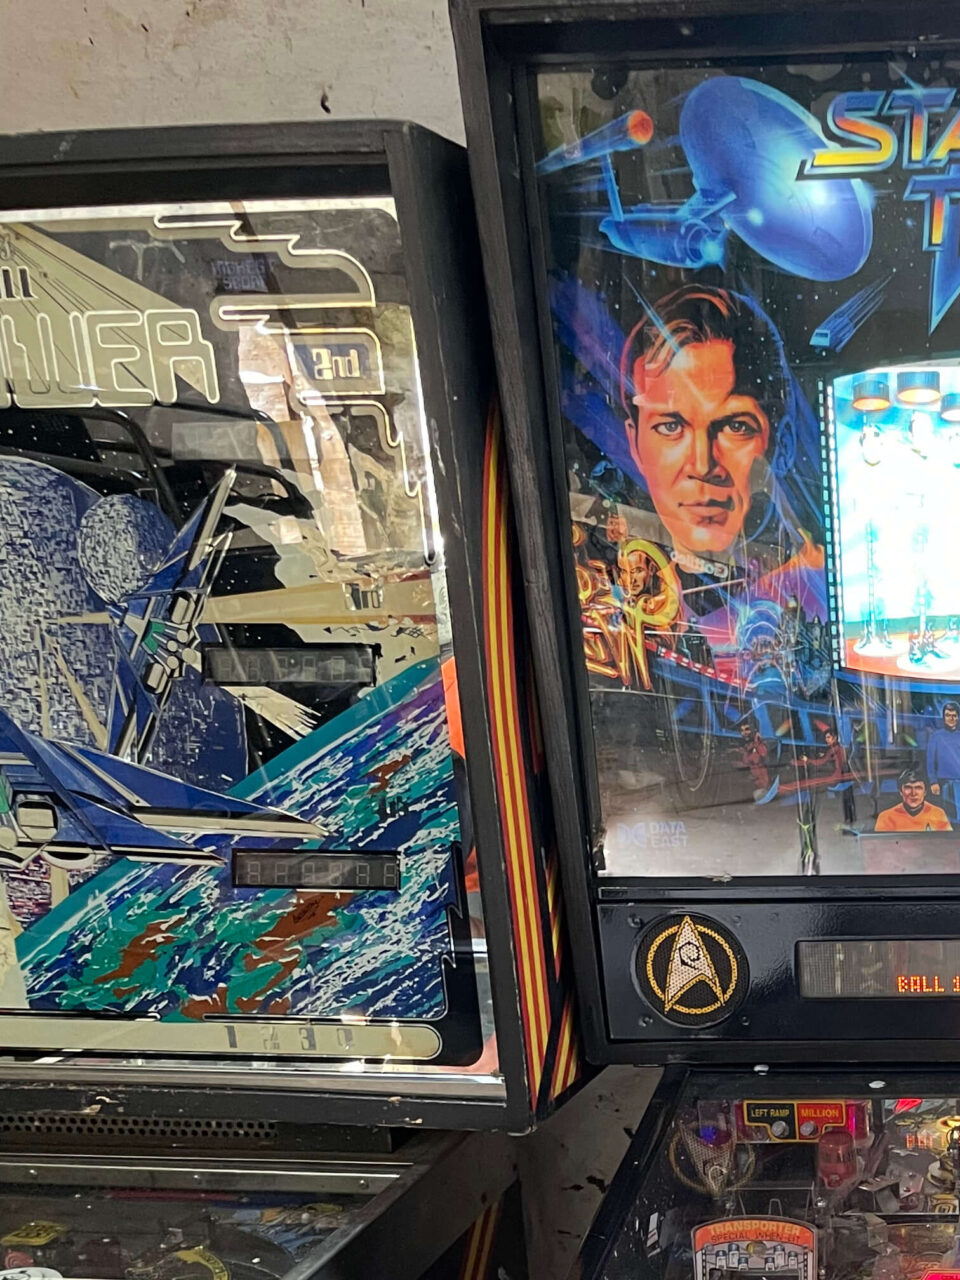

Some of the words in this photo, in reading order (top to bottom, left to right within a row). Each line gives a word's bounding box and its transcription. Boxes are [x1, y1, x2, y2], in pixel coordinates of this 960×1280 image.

[311, 348, 361, 380] 2nd
[649, 821, 686, 835] DATA
[651, 835, 688, 849] EAST
[897, 976, 945, 993] BALL
[751, 1109, 768, 1117] LEFT
[769, 1109, 790, 1118] RAMP
[801, 1108, 839, 1118] MILLION
[709, 1220, 802, 1236] TRANSPORTER
[711, 1231, 748, 1242] SPECIAL
